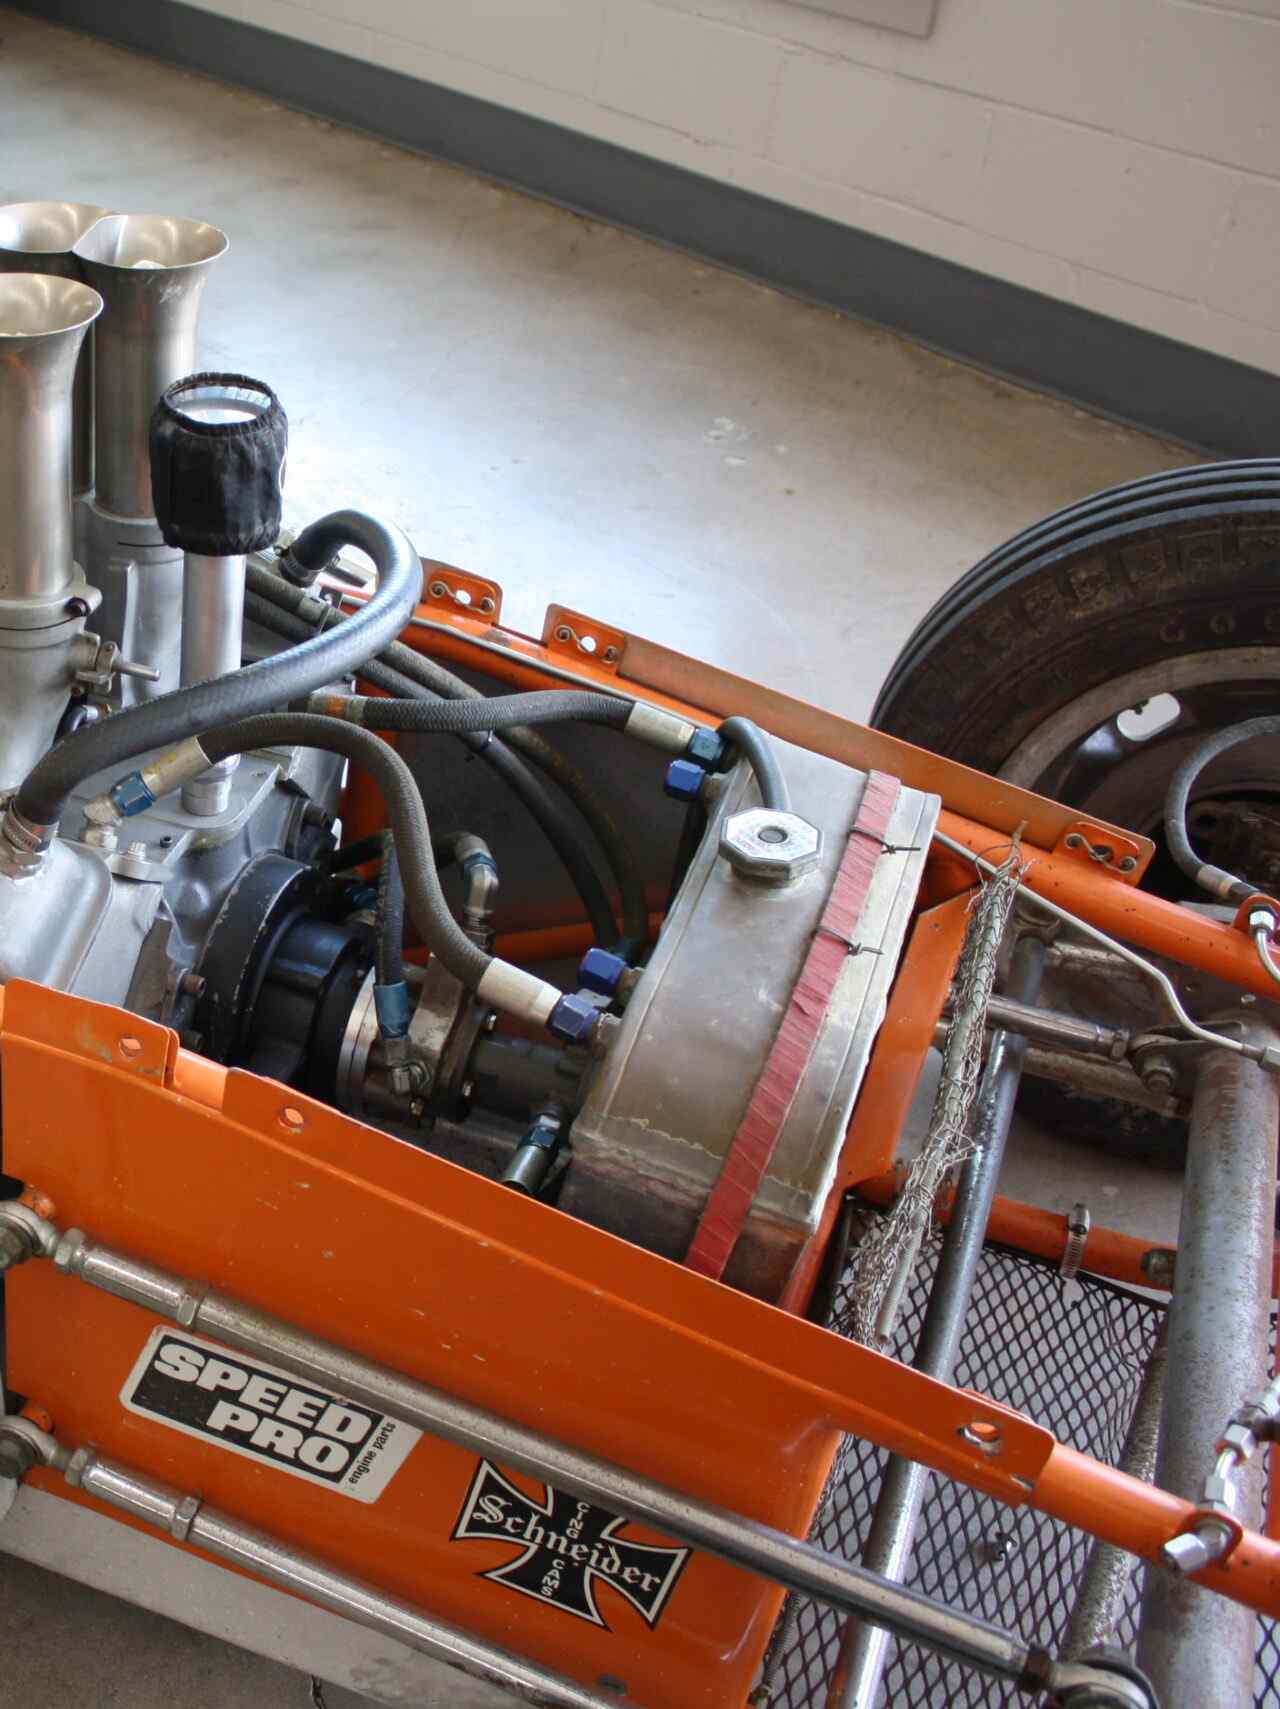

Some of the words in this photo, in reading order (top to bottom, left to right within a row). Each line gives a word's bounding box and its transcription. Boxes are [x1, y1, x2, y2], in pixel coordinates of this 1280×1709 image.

[154, 1343, 373, 1445] SPEED
[206, 1400, 351, 1474] PRO
[348, 1450, 377, 1484] engine
[372, 1422, 396, 1450] parts
[472, 1494, 662, 1593] Schneider
[565, 1502, 591, 1539] CING
[540, 1559, 565, 1597] CAMS
